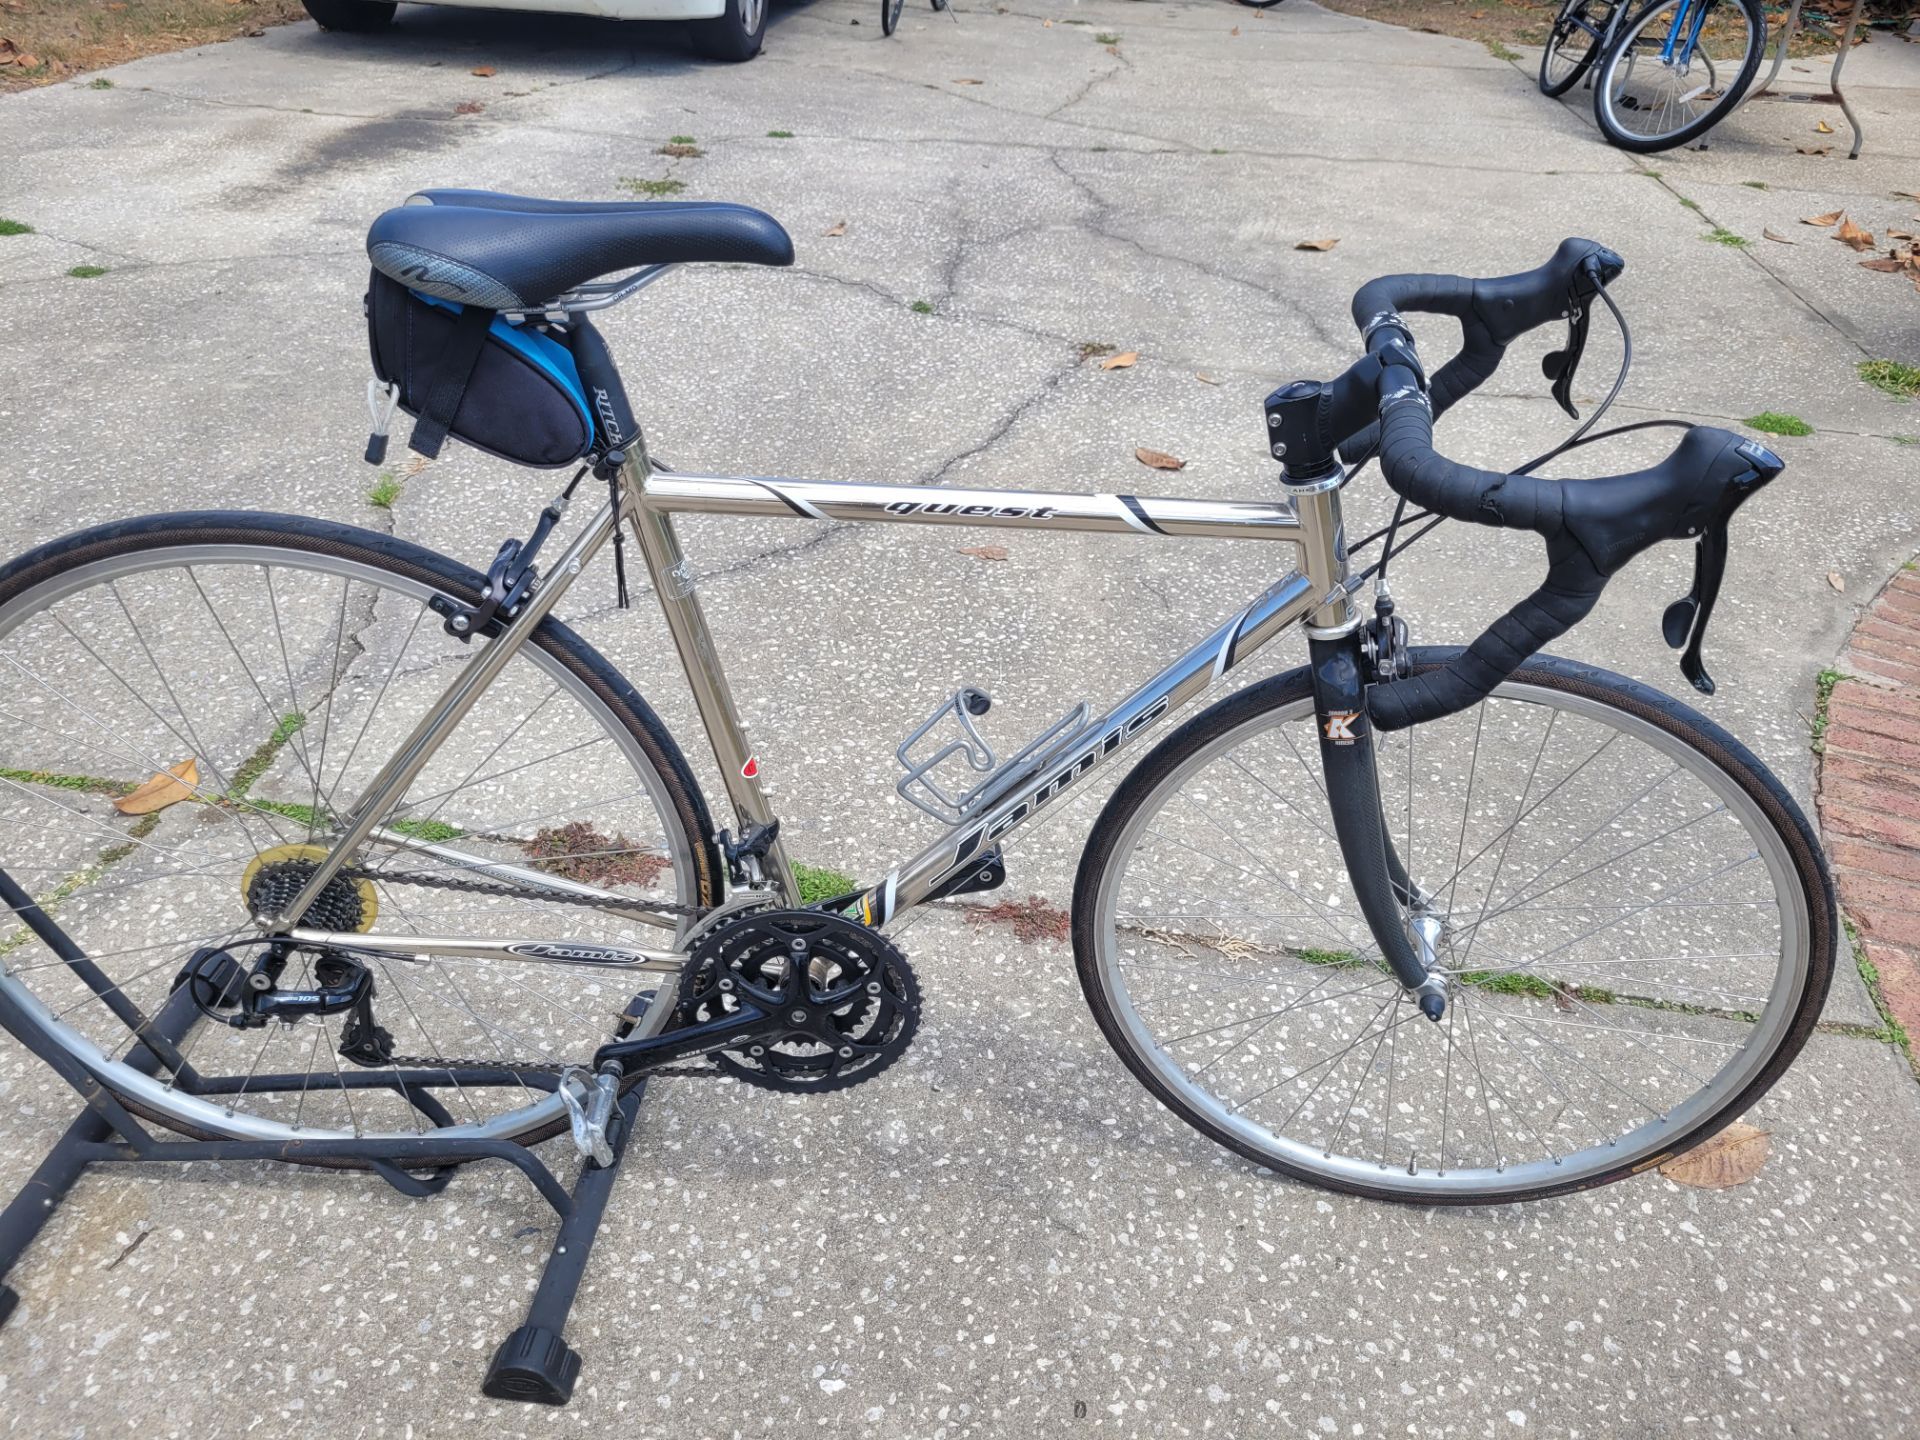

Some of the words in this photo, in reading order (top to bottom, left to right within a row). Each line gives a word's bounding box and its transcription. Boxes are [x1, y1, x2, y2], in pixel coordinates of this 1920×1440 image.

[885, 501, 1058, 520] quest
[929, 695, 1168, 887] Jamis
[516, 945, 636, 962] Jamis
